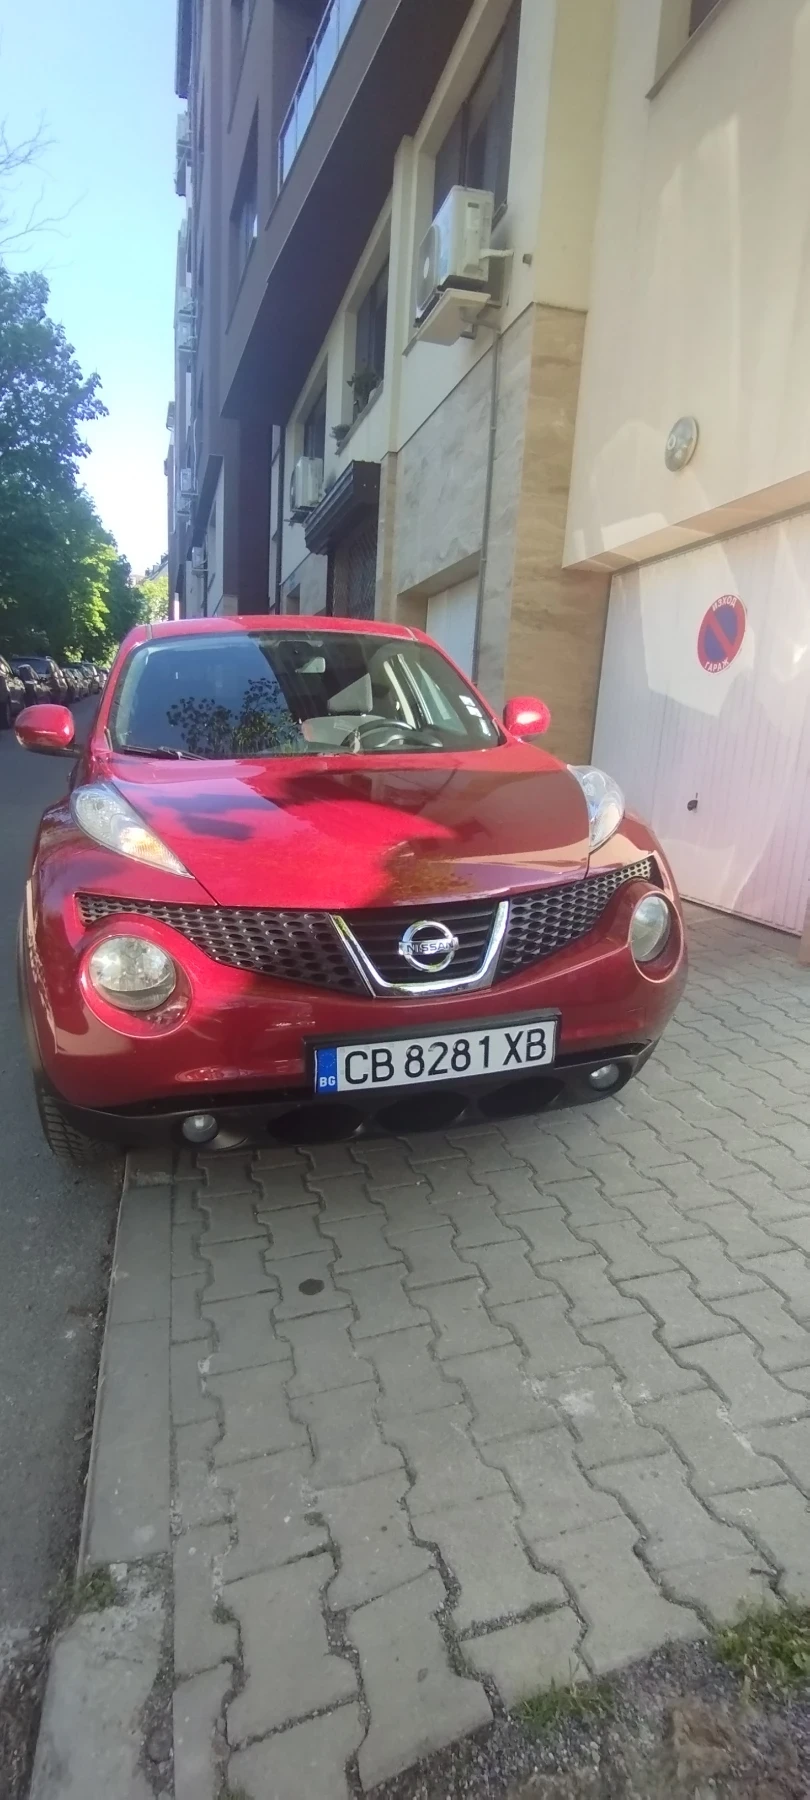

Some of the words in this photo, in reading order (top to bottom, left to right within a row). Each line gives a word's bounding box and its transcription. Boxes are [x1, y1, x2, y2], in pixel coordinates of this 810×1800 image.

[712, 596, 737, 611] ИЗХОД
[704, 657, 730, 672] ГАРАЖ
[406, 942, 454, 953] NISSAN
[404, 1035, 491, 1079] 8281
[319, 1076, 336, 1088] BG
